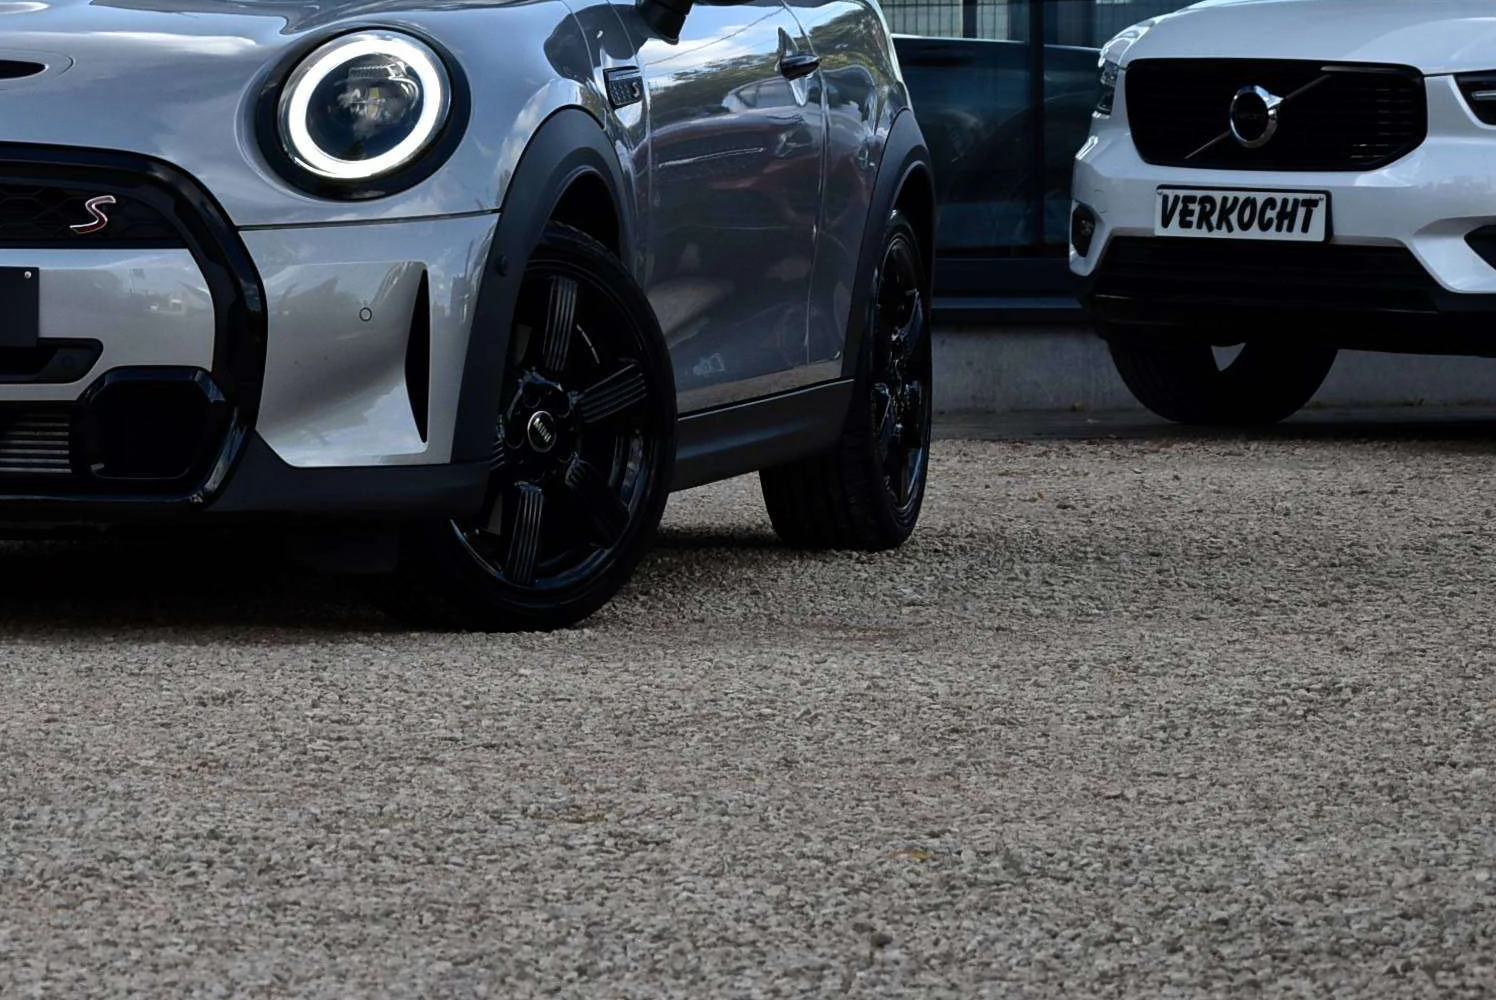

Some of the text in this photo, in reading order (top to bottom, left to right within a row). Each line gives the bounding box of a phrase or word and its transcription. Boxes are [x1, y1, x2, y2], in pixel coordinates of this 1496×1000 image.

[69, 195, 116, 234] S
[1159, 194, 1320, 234] VERKOCHT
[533, 417, 552, 442] MINI
